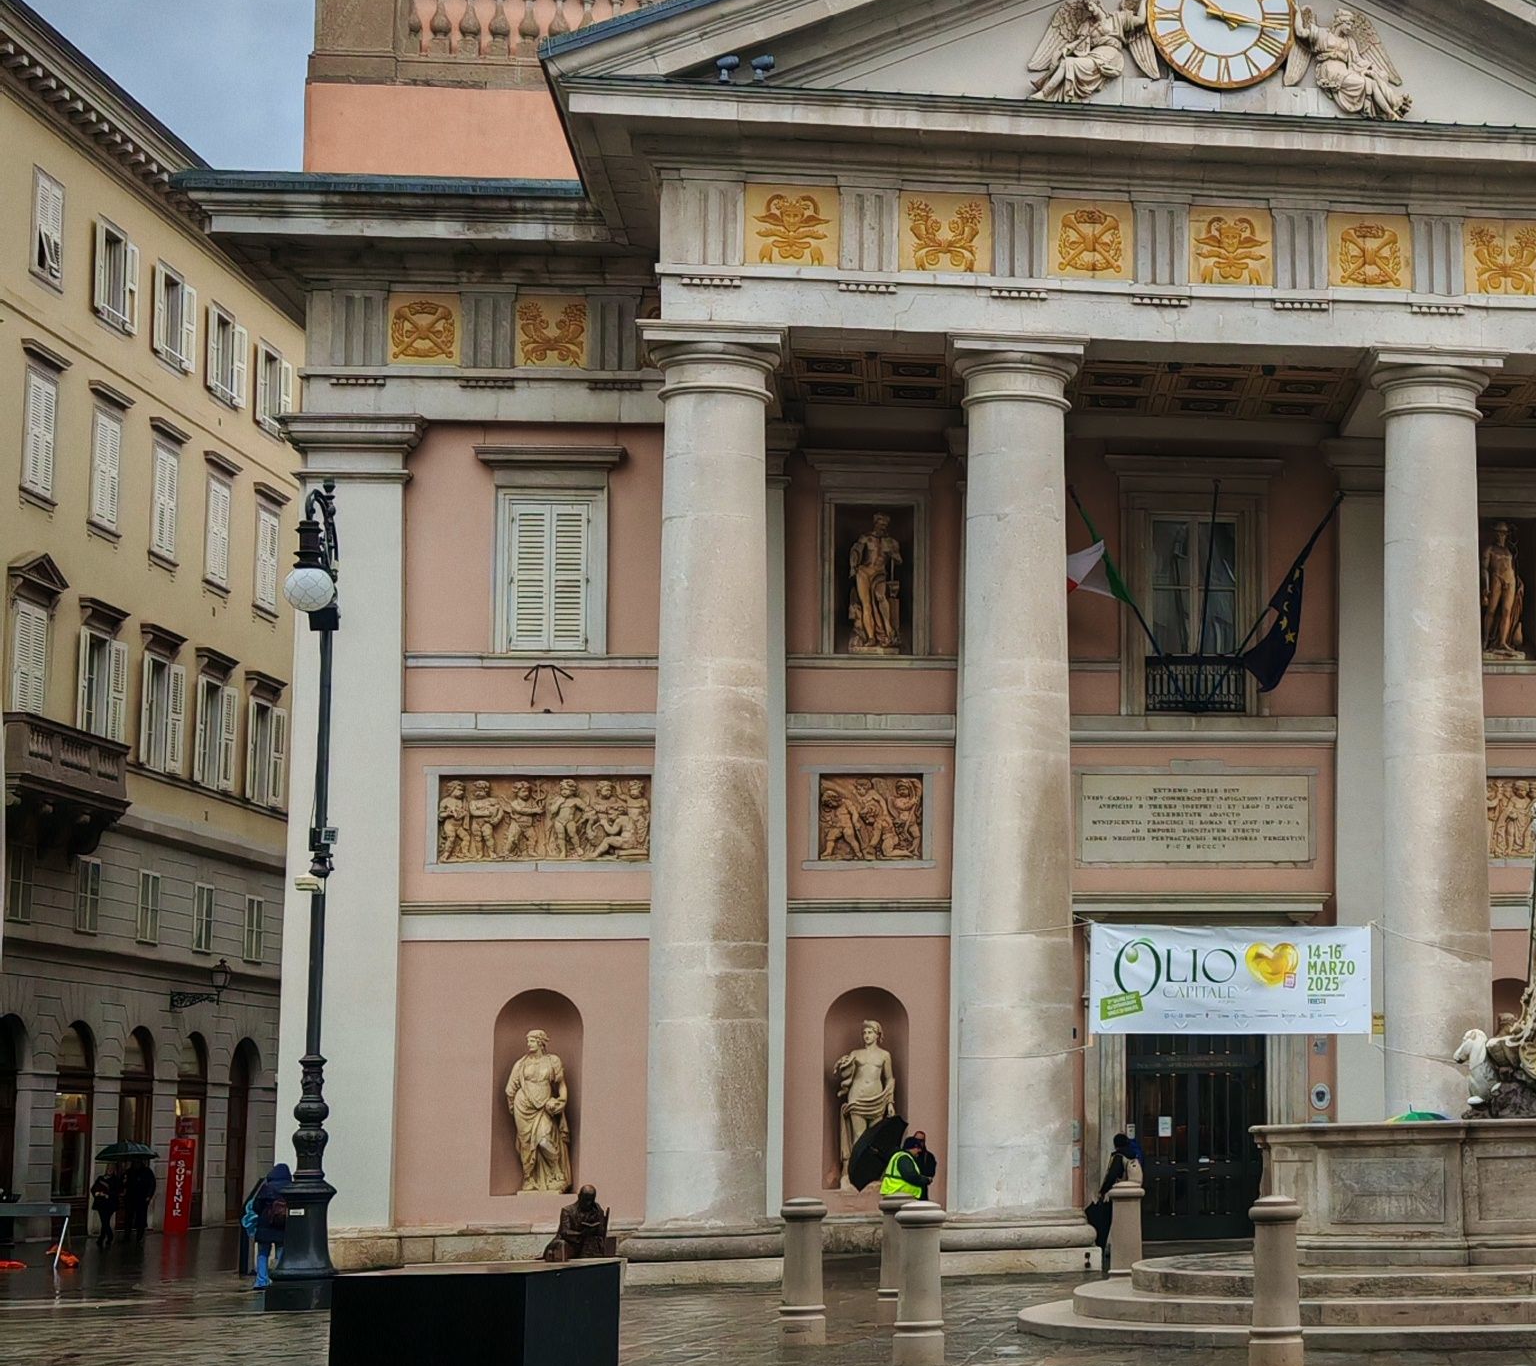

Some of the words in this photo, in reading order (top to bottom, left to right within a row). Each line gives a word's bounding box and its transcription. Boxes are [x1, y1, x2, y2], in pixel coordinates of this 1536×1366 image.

[1307, 944, 1342, 960] 14-16
[1113, 939, 1238, 998] OLIO
[1307, 960, 1356, 976] MARZO
[1162, 985, 1237, 999] CAPITALE
[1307, 976, 1340, 992] 2025
[172, 1159, 186, 1217] SOUVENIR
